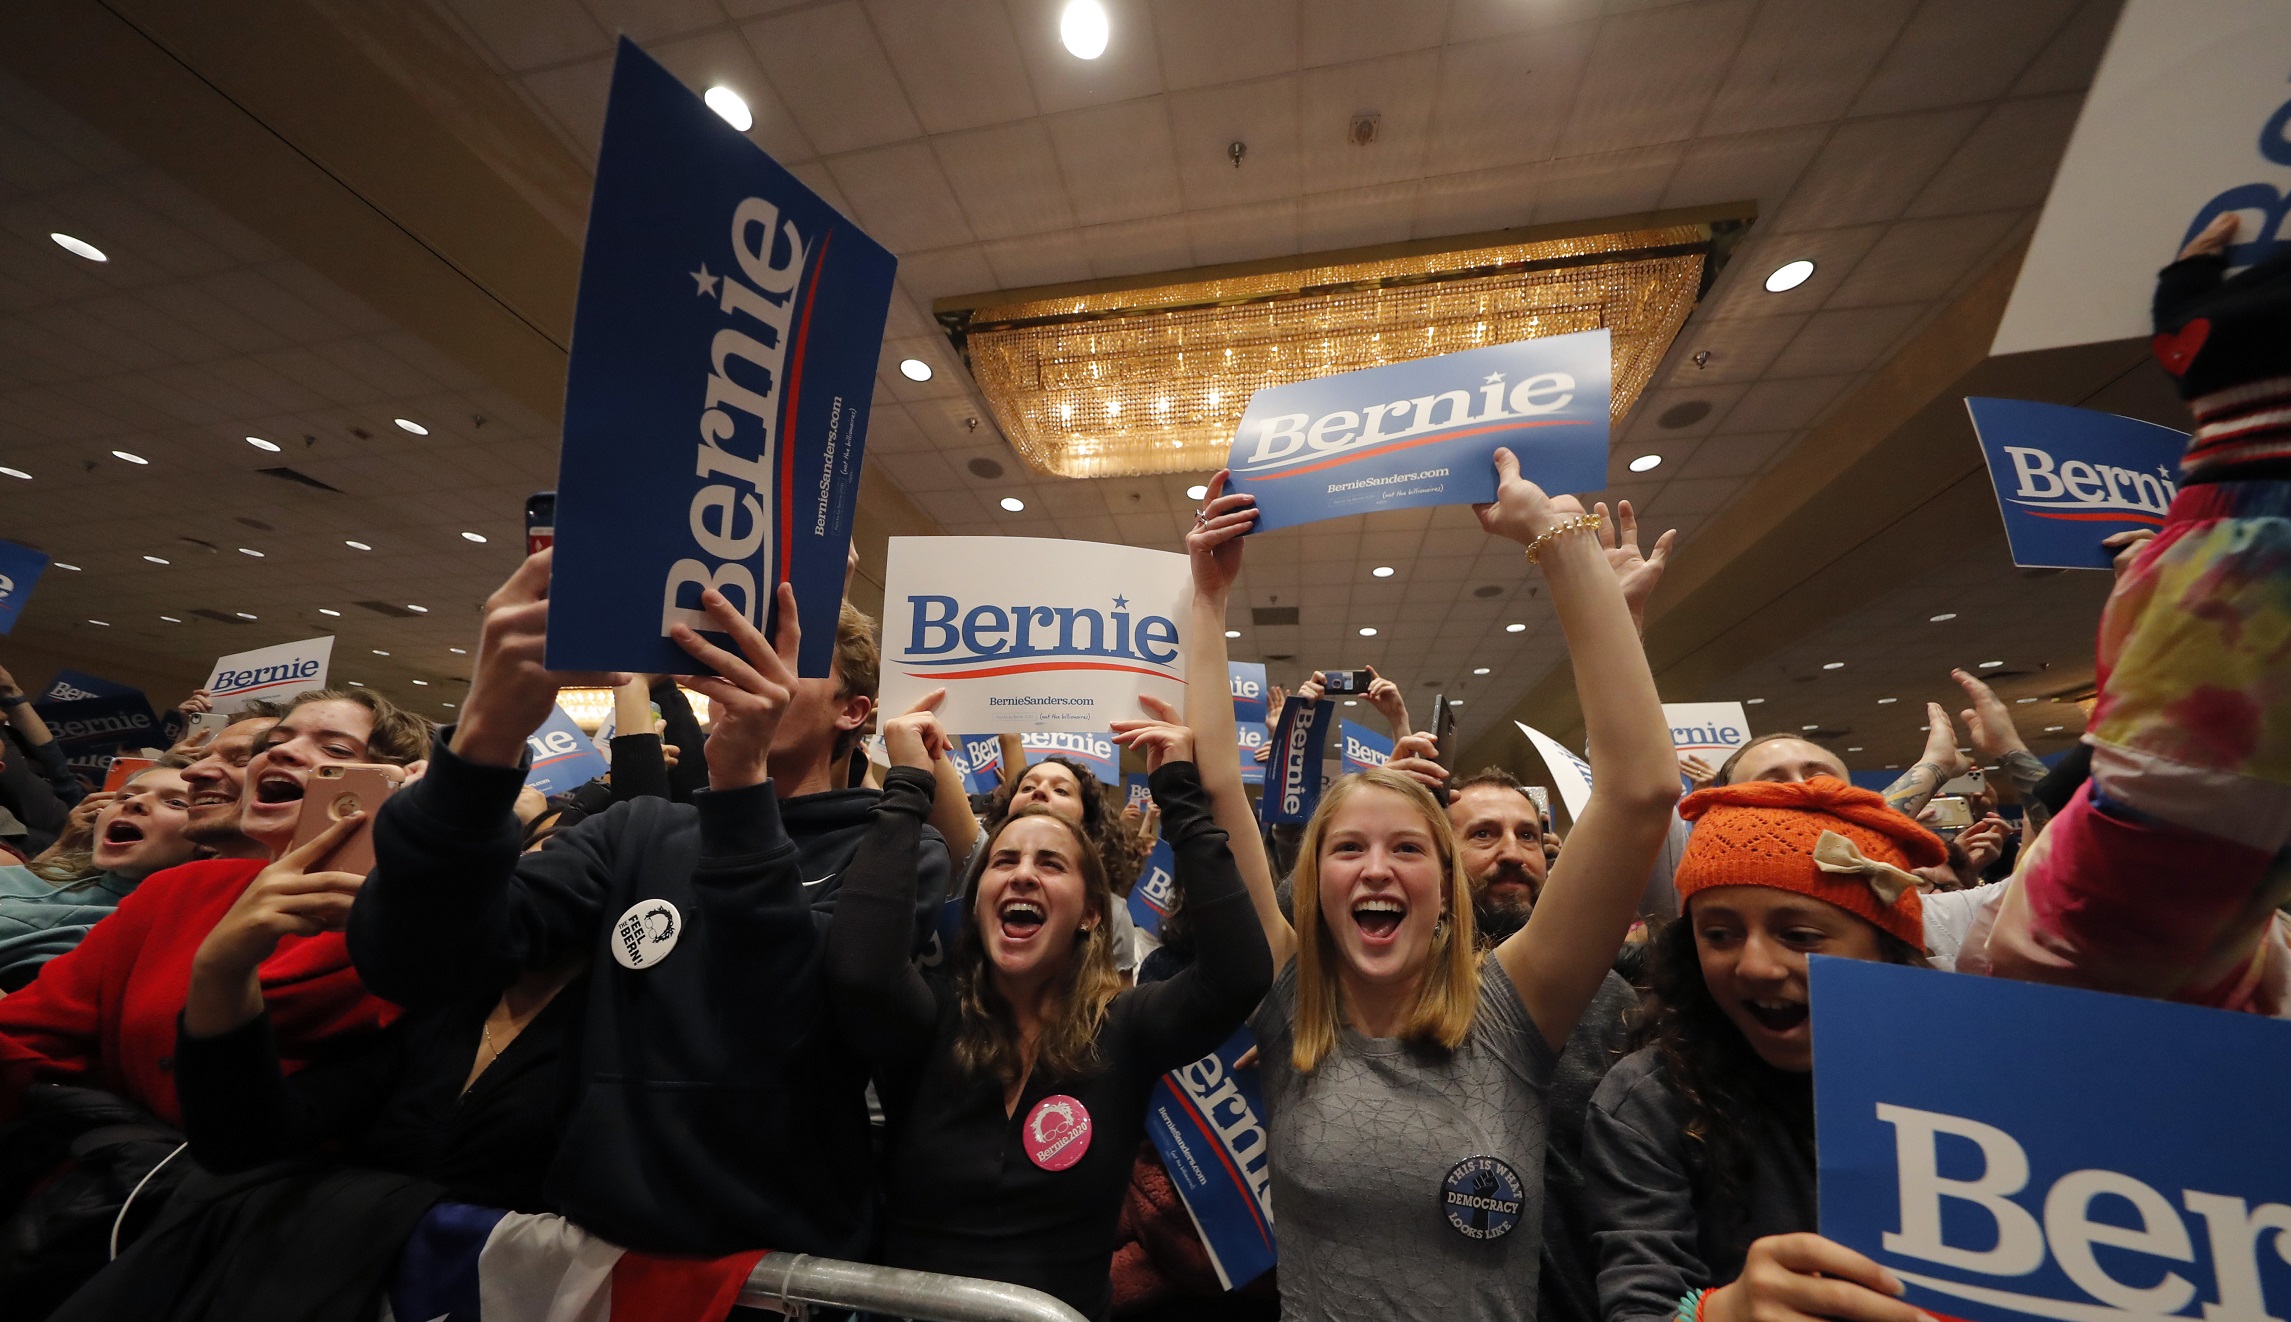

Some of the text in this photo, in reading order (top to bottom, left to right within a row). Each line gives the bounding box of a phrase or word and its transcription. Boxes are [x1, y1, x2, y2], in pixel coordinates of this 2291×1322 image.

[661, 196, 804, 641] Bernie
[1247, 371, 1577, 464] Bernie
[814, 395, 843, 537] BernieSanders.com
[1327, 467, 1450, 493] BernieSanders.com
[2003, 446, 2178, 515] Berni
[904, 593, 1180, 664] Bernie
[211, 657, 319, 691] Bernie
[989, 696, 1094, 706] BernieSanders.com
[1670, 721, 1741, 745] rnie
[1283, 705, 1316, 815] Bernie
[618, 920, 628, 929] THE
[628, 914, 646, 945] FEEL
[620, 926, 643, 966] BERN!
[1036, 1136, 1069, 1162] Bernie
[1068, 1122, 1088, 1141] 2020
[1158, 1106, 1208, 1186] BernieSanders.com
[1447, 1159, 1523, 1199] THIS IS WHAT
[1447, 1191, 1519, 1214] DEMOCRACY
[1876, 1102, 2291, 1322] Ber
[1448, 1212, 1512, 1239] LOOKS LIKE
